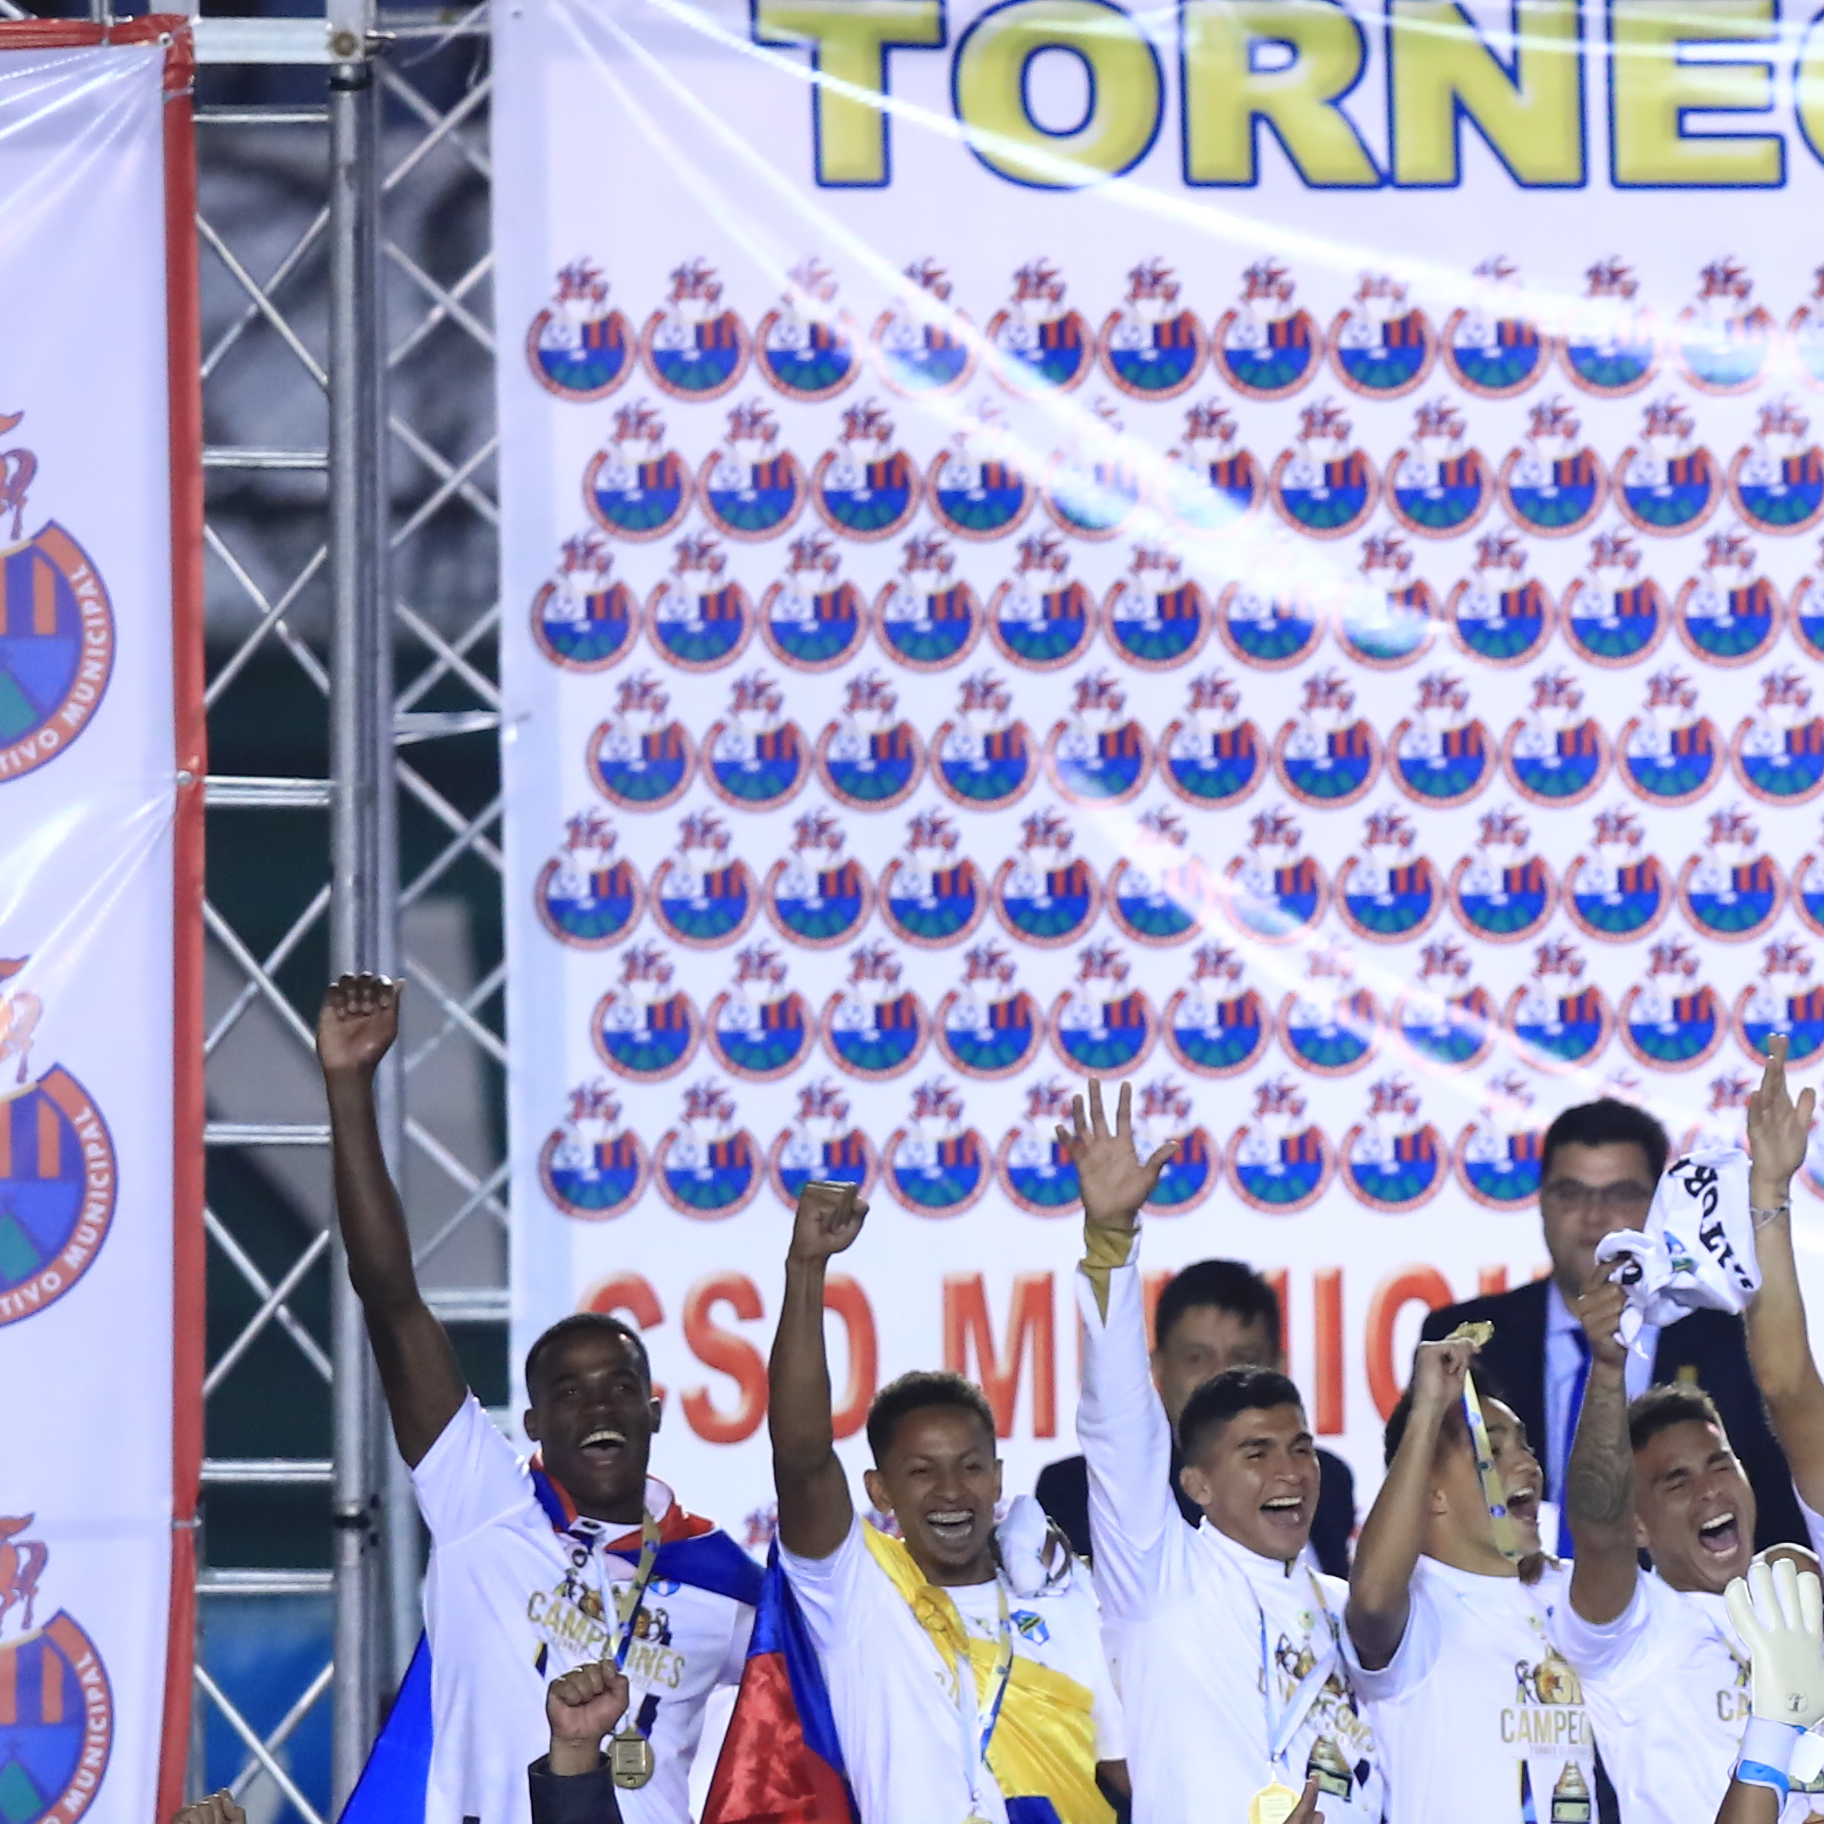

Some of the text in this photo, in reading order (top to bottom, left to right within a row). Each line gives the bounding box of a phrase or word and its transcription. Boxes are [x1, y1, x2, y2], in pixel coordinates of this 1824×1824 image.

[61, 563, 107, 728] MUNICIPAL
[63, 1106, 109, 1271] MUNICIPAL
[63, 1650, 110, 1814] MUNICIPAL
